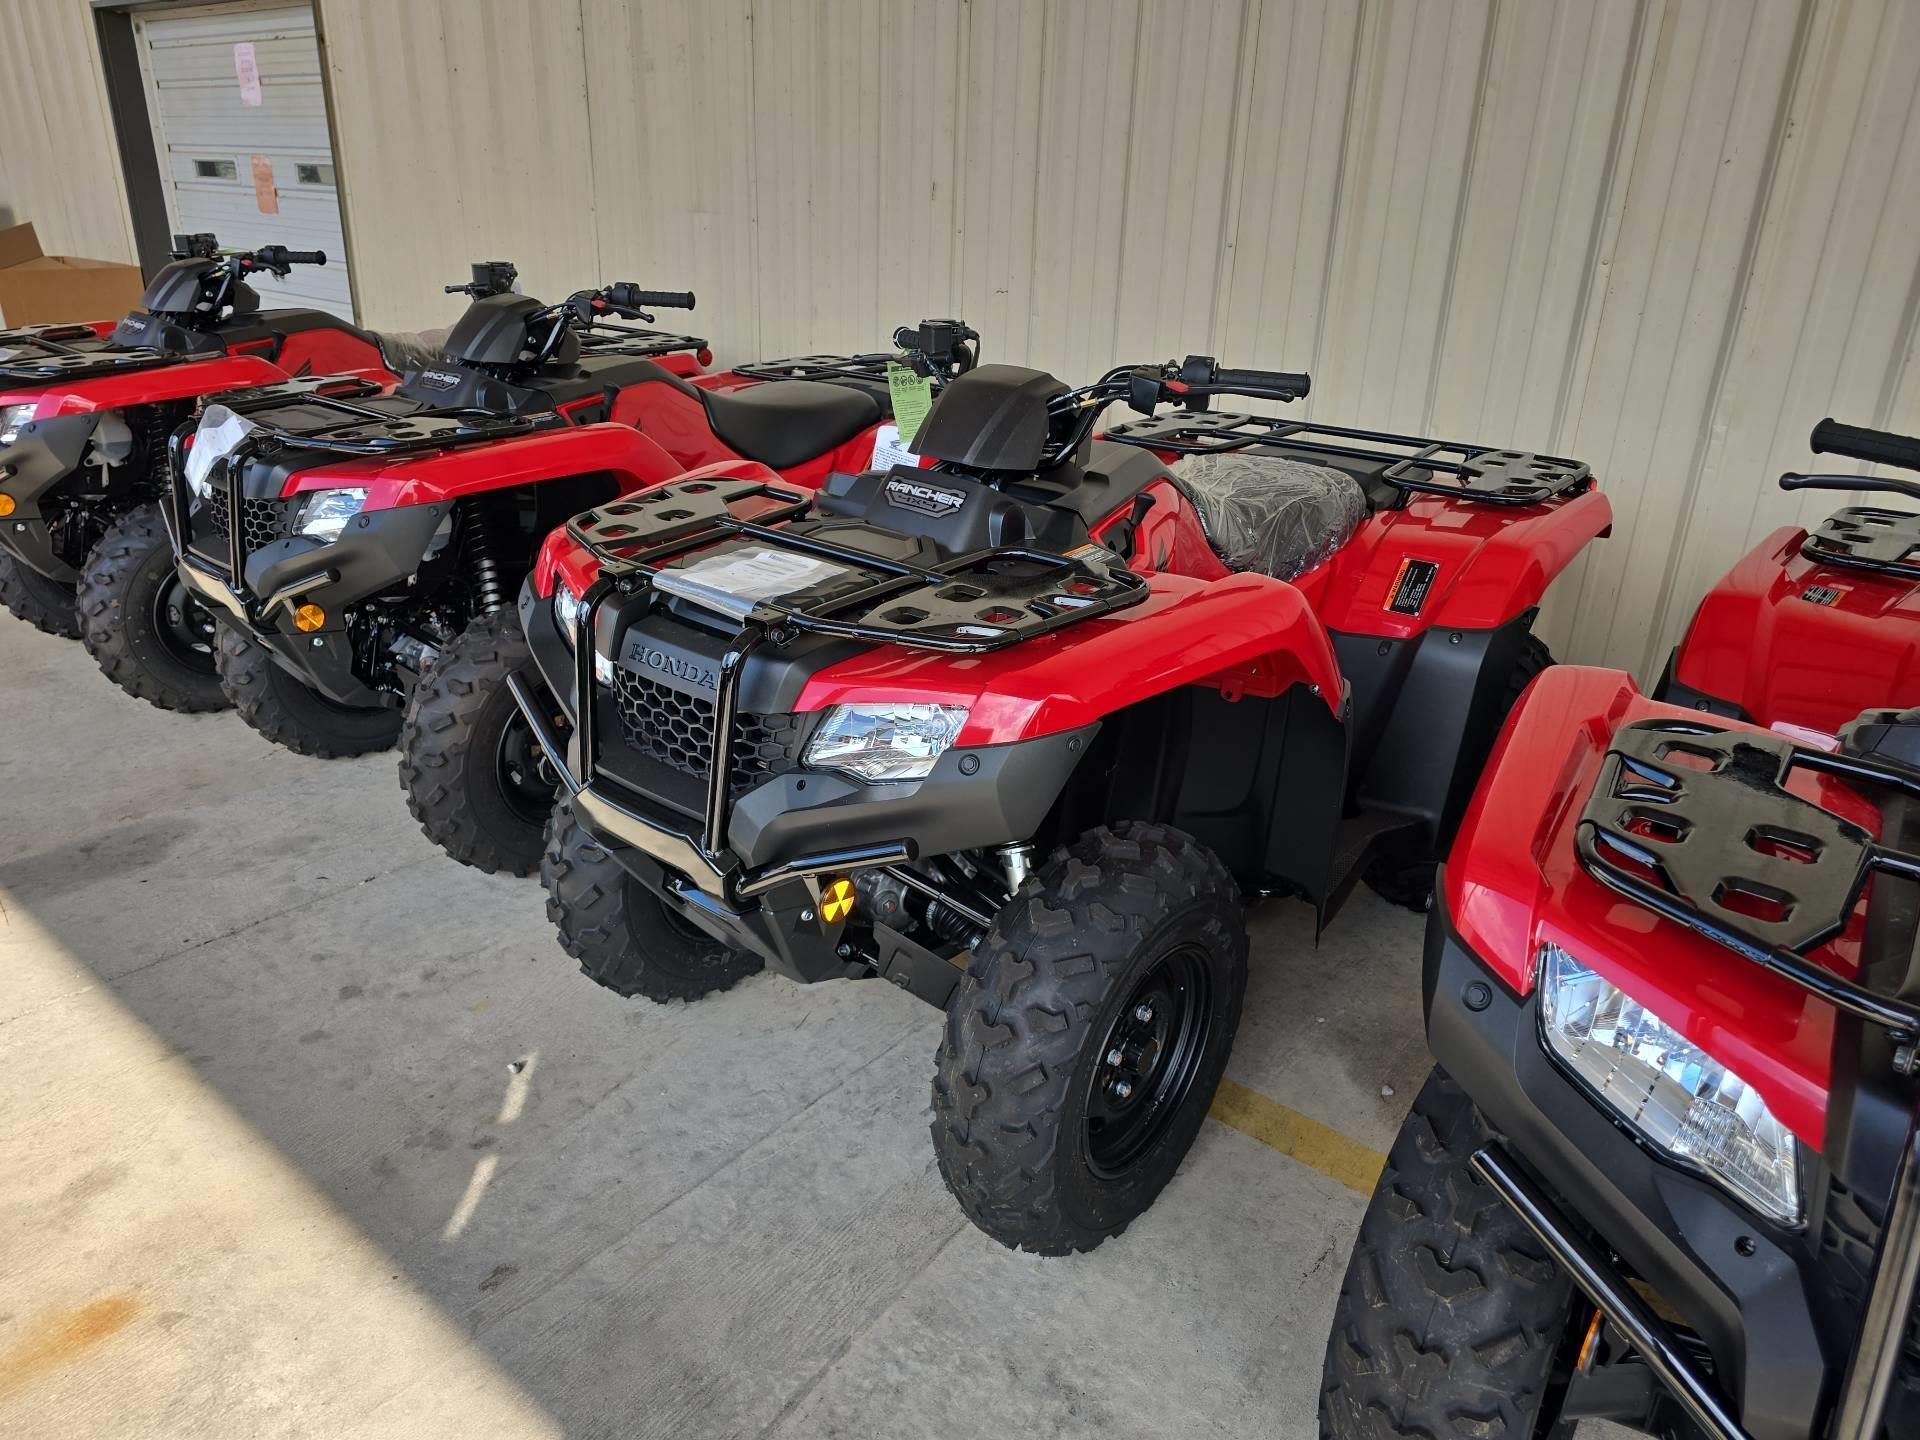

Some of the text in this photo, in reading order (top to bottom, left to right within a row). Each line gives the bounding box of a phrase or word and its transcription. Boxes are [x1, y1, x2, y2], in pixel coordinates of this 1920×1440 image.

[886, 480, 964, 508] RANCHER
[1391, 568, 1406, 593] WARNING
[628, 642, 718, 691] HONDA
